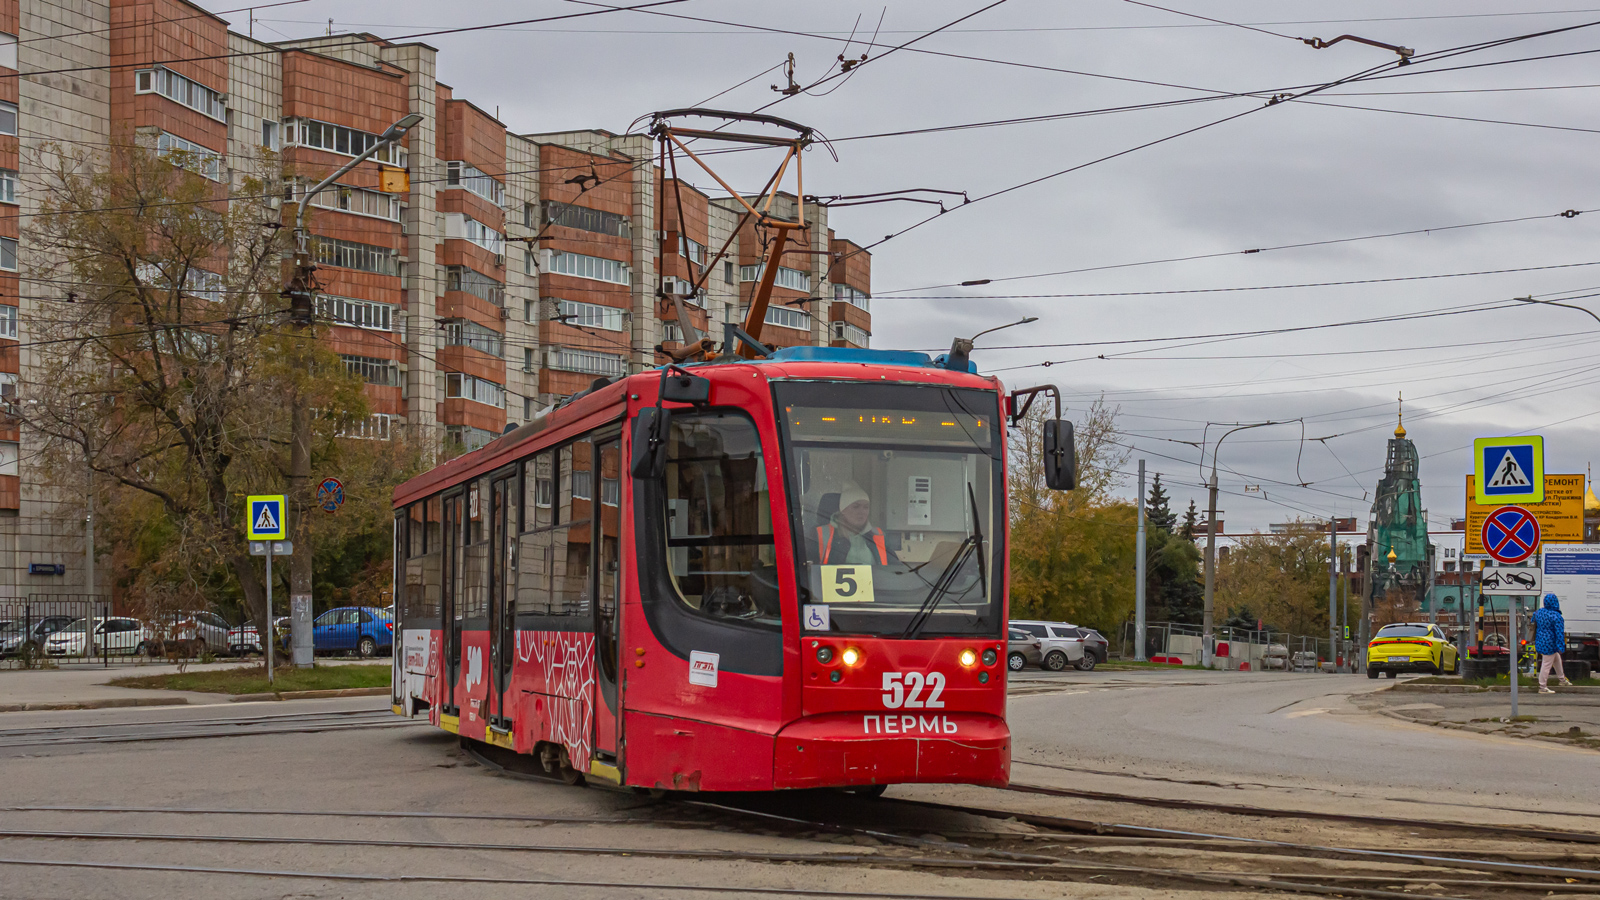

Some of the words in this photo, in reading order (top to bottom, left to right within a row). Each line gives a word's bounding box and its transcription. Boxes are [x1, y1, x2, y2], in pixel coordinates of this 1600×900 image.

[835, 568, 857, 597] 5
[882, 672, 946, 708] 522
[864, 715, 958, 733] ПЕРМЬ
